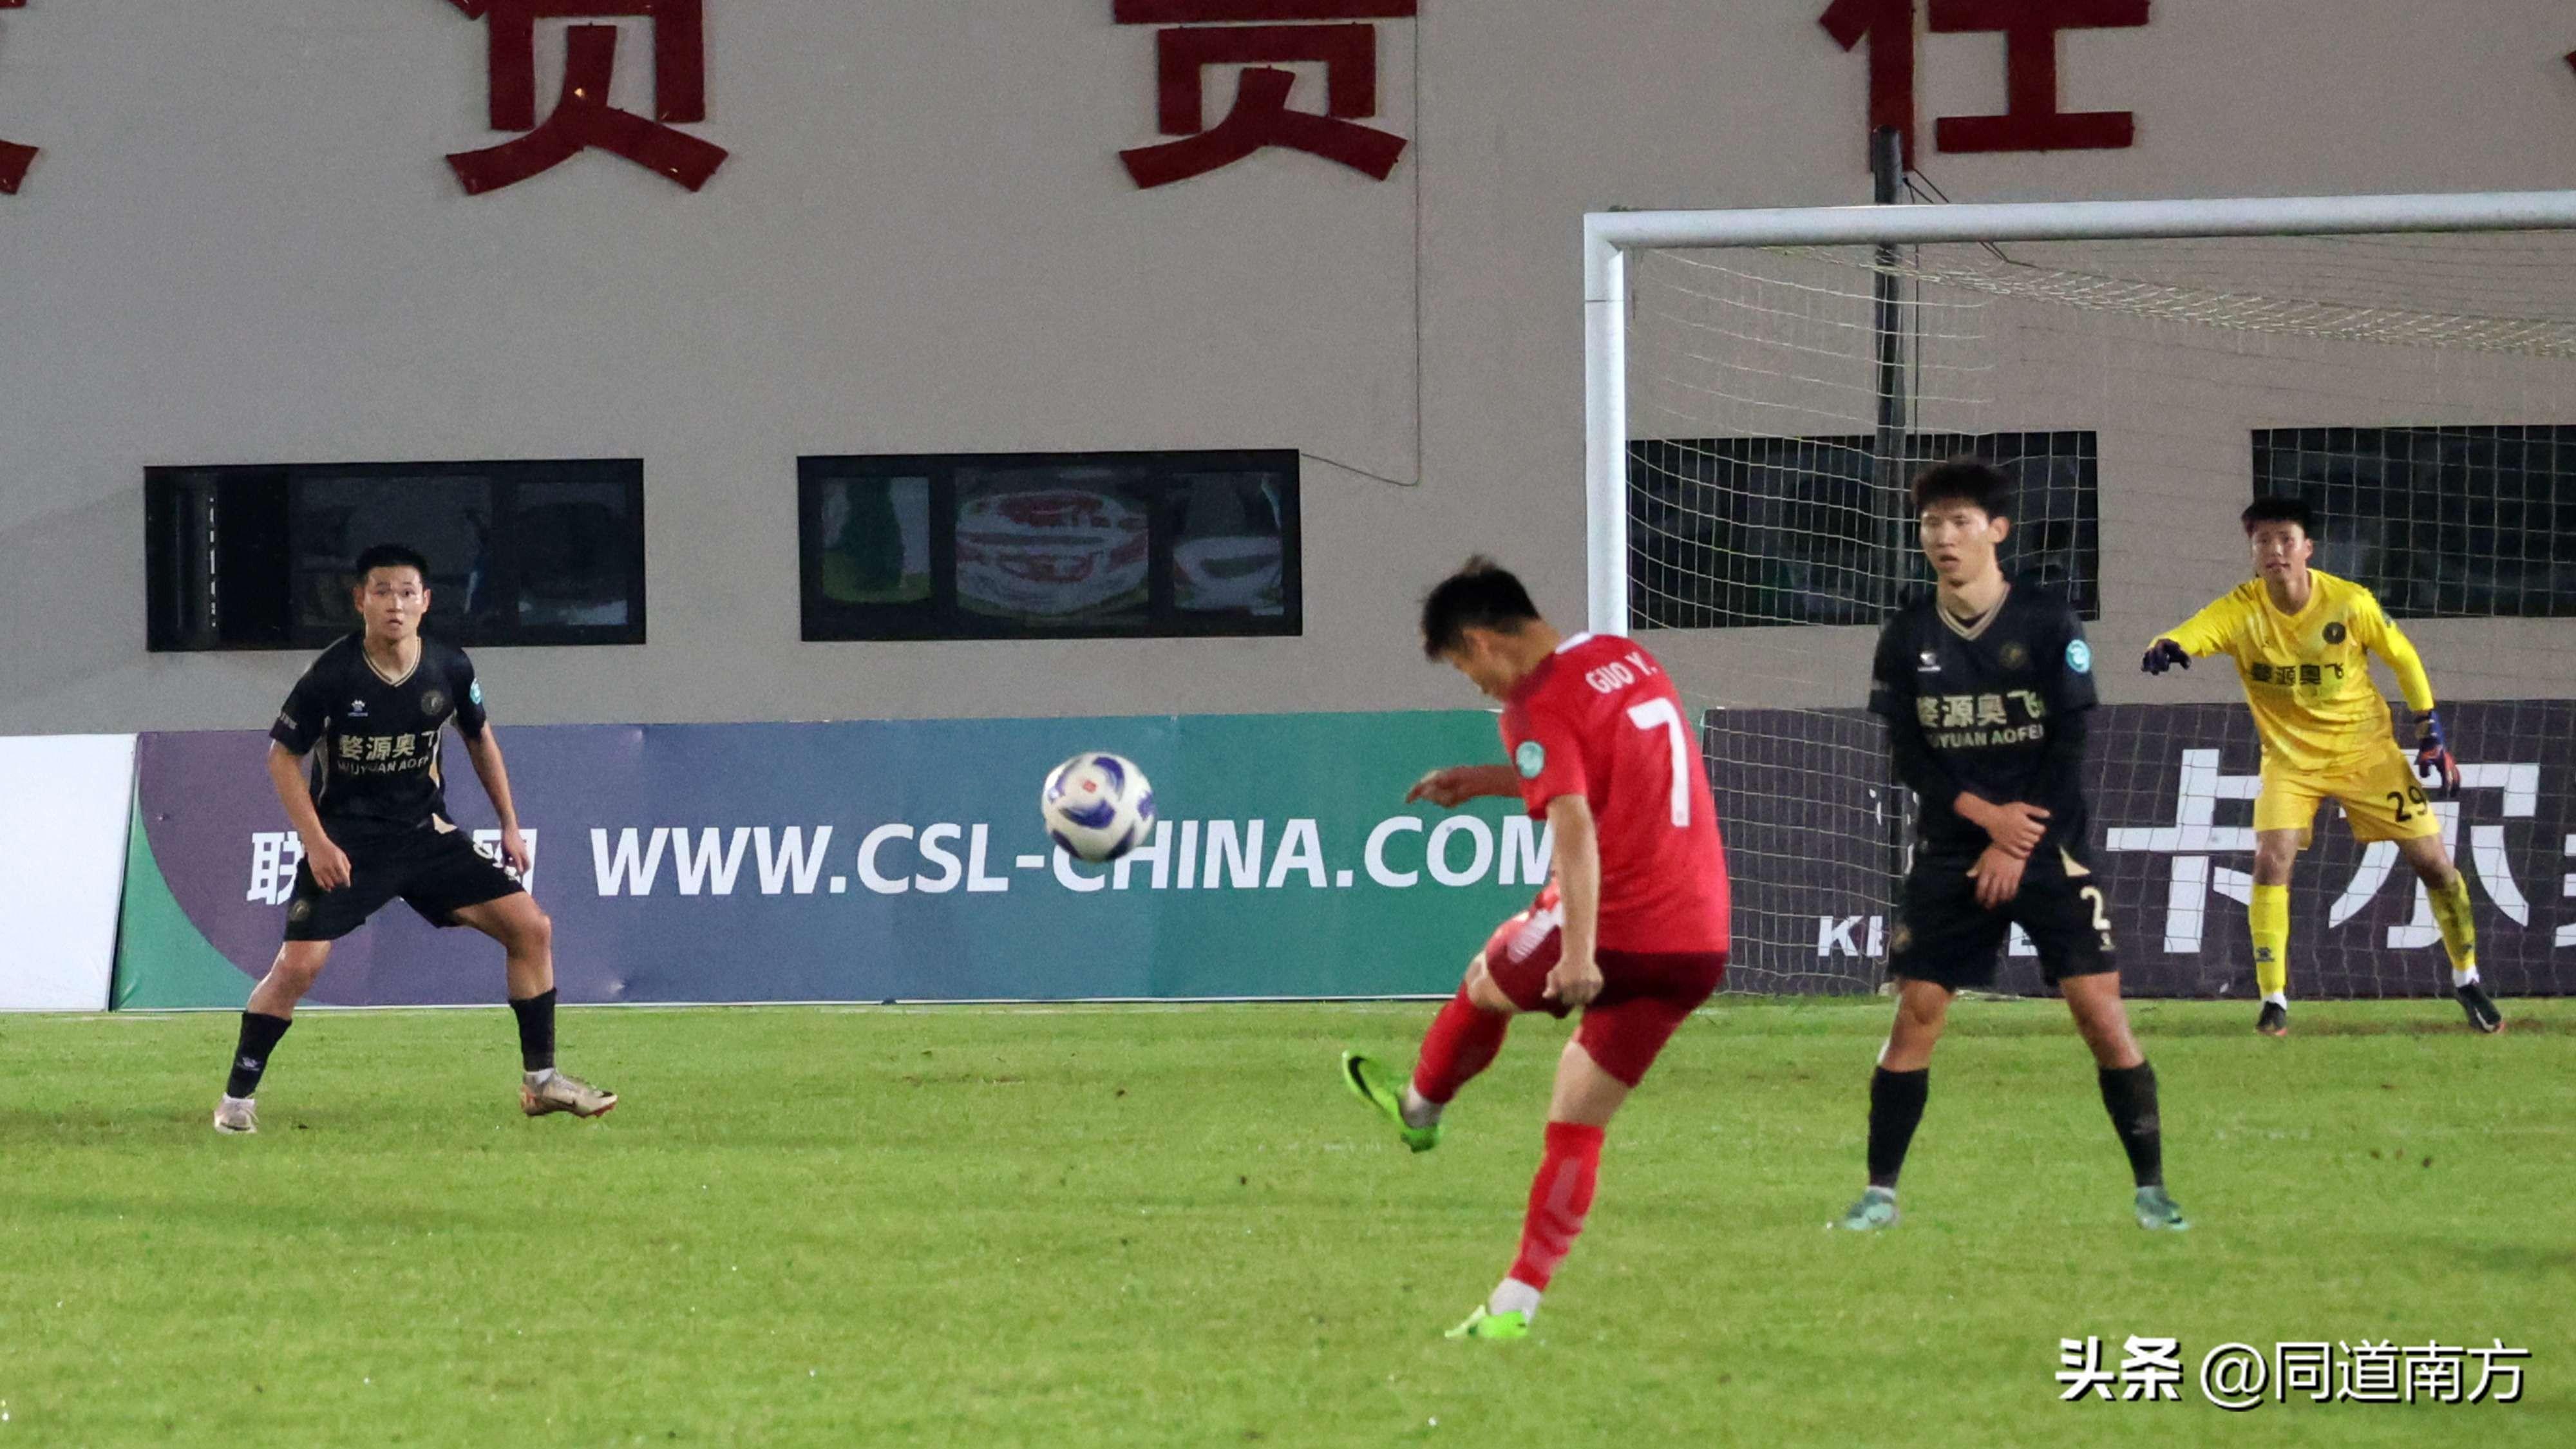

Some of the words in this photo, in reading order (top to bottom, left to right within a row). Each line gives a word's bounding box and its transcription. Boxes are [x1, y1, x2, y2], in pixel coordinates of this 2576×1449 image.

[1585, 661, 1636, 694] GUO
[1624, 651, 1658, 676] Y.
[1626, 696, 1690, 828] 7
[2387, 785, 2428, 822] 29
